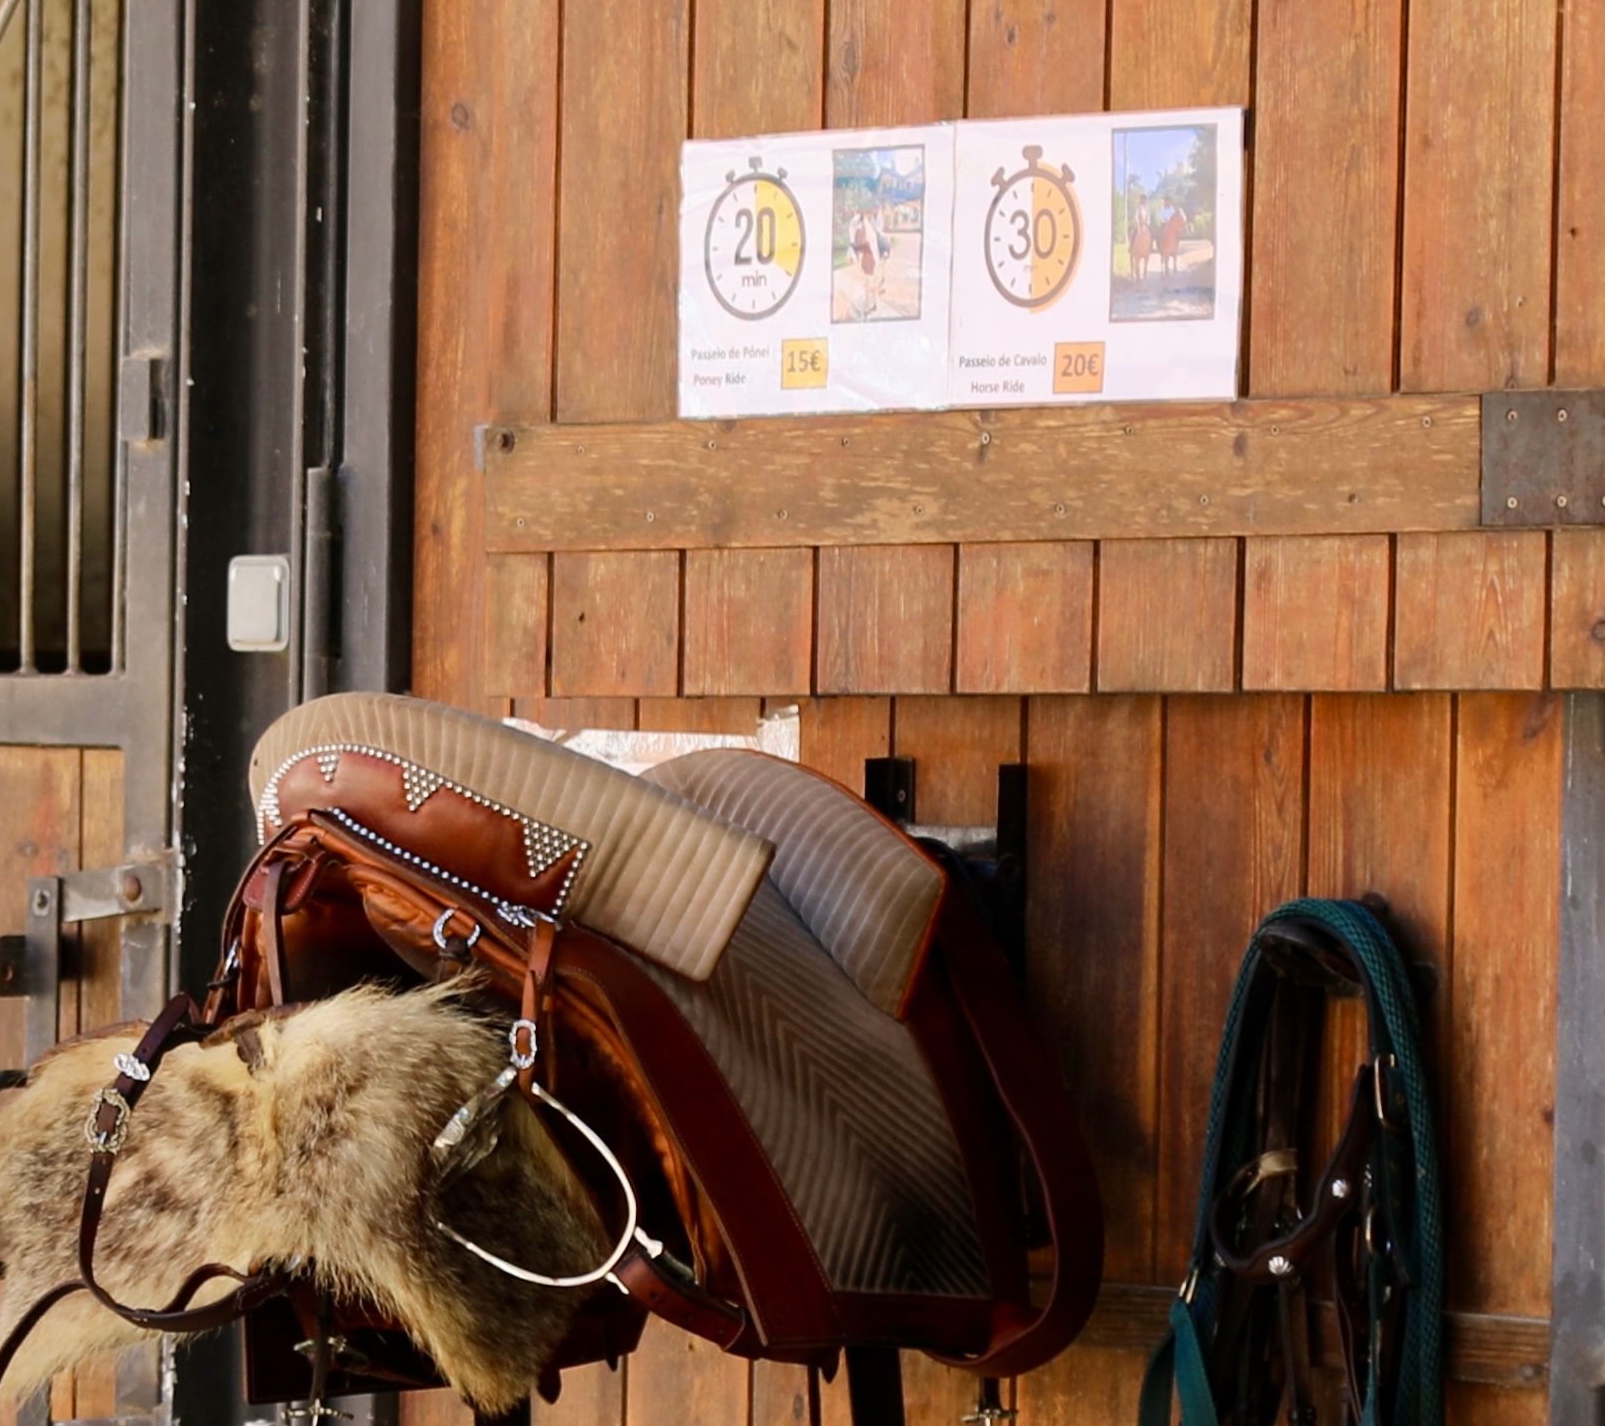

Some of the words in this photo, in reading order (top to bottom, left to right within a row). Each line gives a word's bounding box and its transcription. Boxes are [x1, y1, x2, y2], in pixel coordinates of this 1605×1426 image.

[734, 207, 776, 265] 20
[1008, 209, 1057, 260] 30
[742, 270, 767, 287] min
[691, 347, 726, 361] Passeio
[728, 348, 740, 359] de
[787, 349, 822, 373] 15€
[959, 355, 996, 368] Passeio
[998, 354, 1011, 367] de
[1013, 353, 1047, 367] Cavalo
[1061, 353, 1100, 377] 20€
[694, 374, 723, 387] Poney
[725, 372, 746, 385] Ride
[971, 381, 1000, 393] Horse
[1002, 380, 1025, 393] Ride
